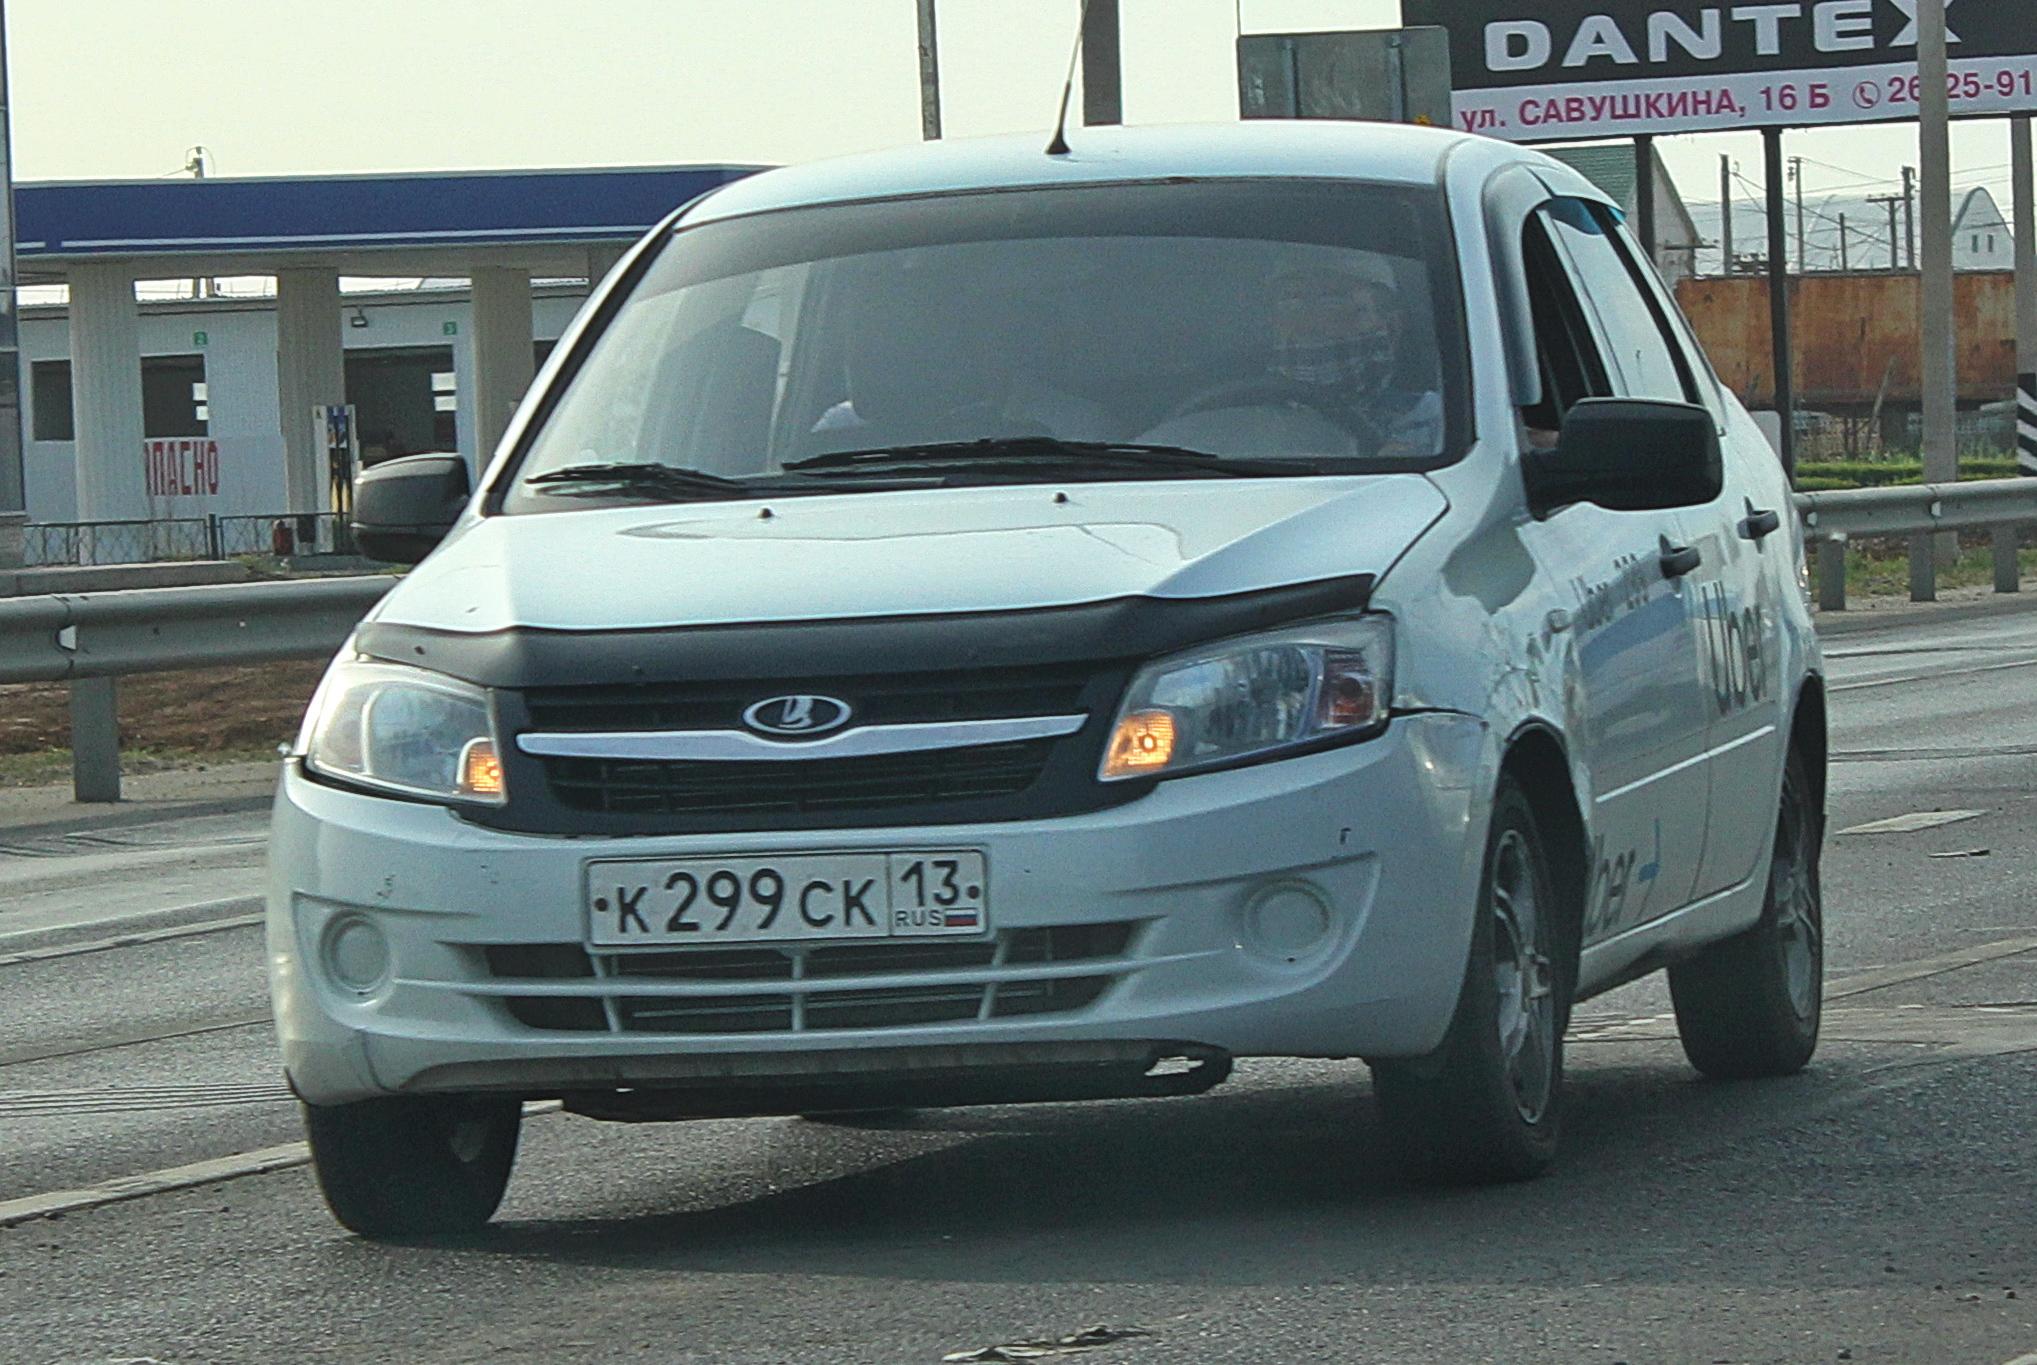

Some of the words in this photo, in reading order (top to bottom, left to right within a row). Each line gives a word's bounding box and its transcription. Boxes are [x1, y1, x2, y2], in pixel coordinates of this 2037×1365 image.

[1484, 0, 1962, 72] DANTEX
[1459, 108, 1506, 133] ул.
[1518, 88, 1746, 126] САВУШКИНА,
[1760, 84, 1798, 112] 16
[1808, 83, 1832, 109] Б
[1887, 69, 2032, 103] 2625-91
[901, 860, 960, 907] 13
[895, 909, 942, 927] RUS
